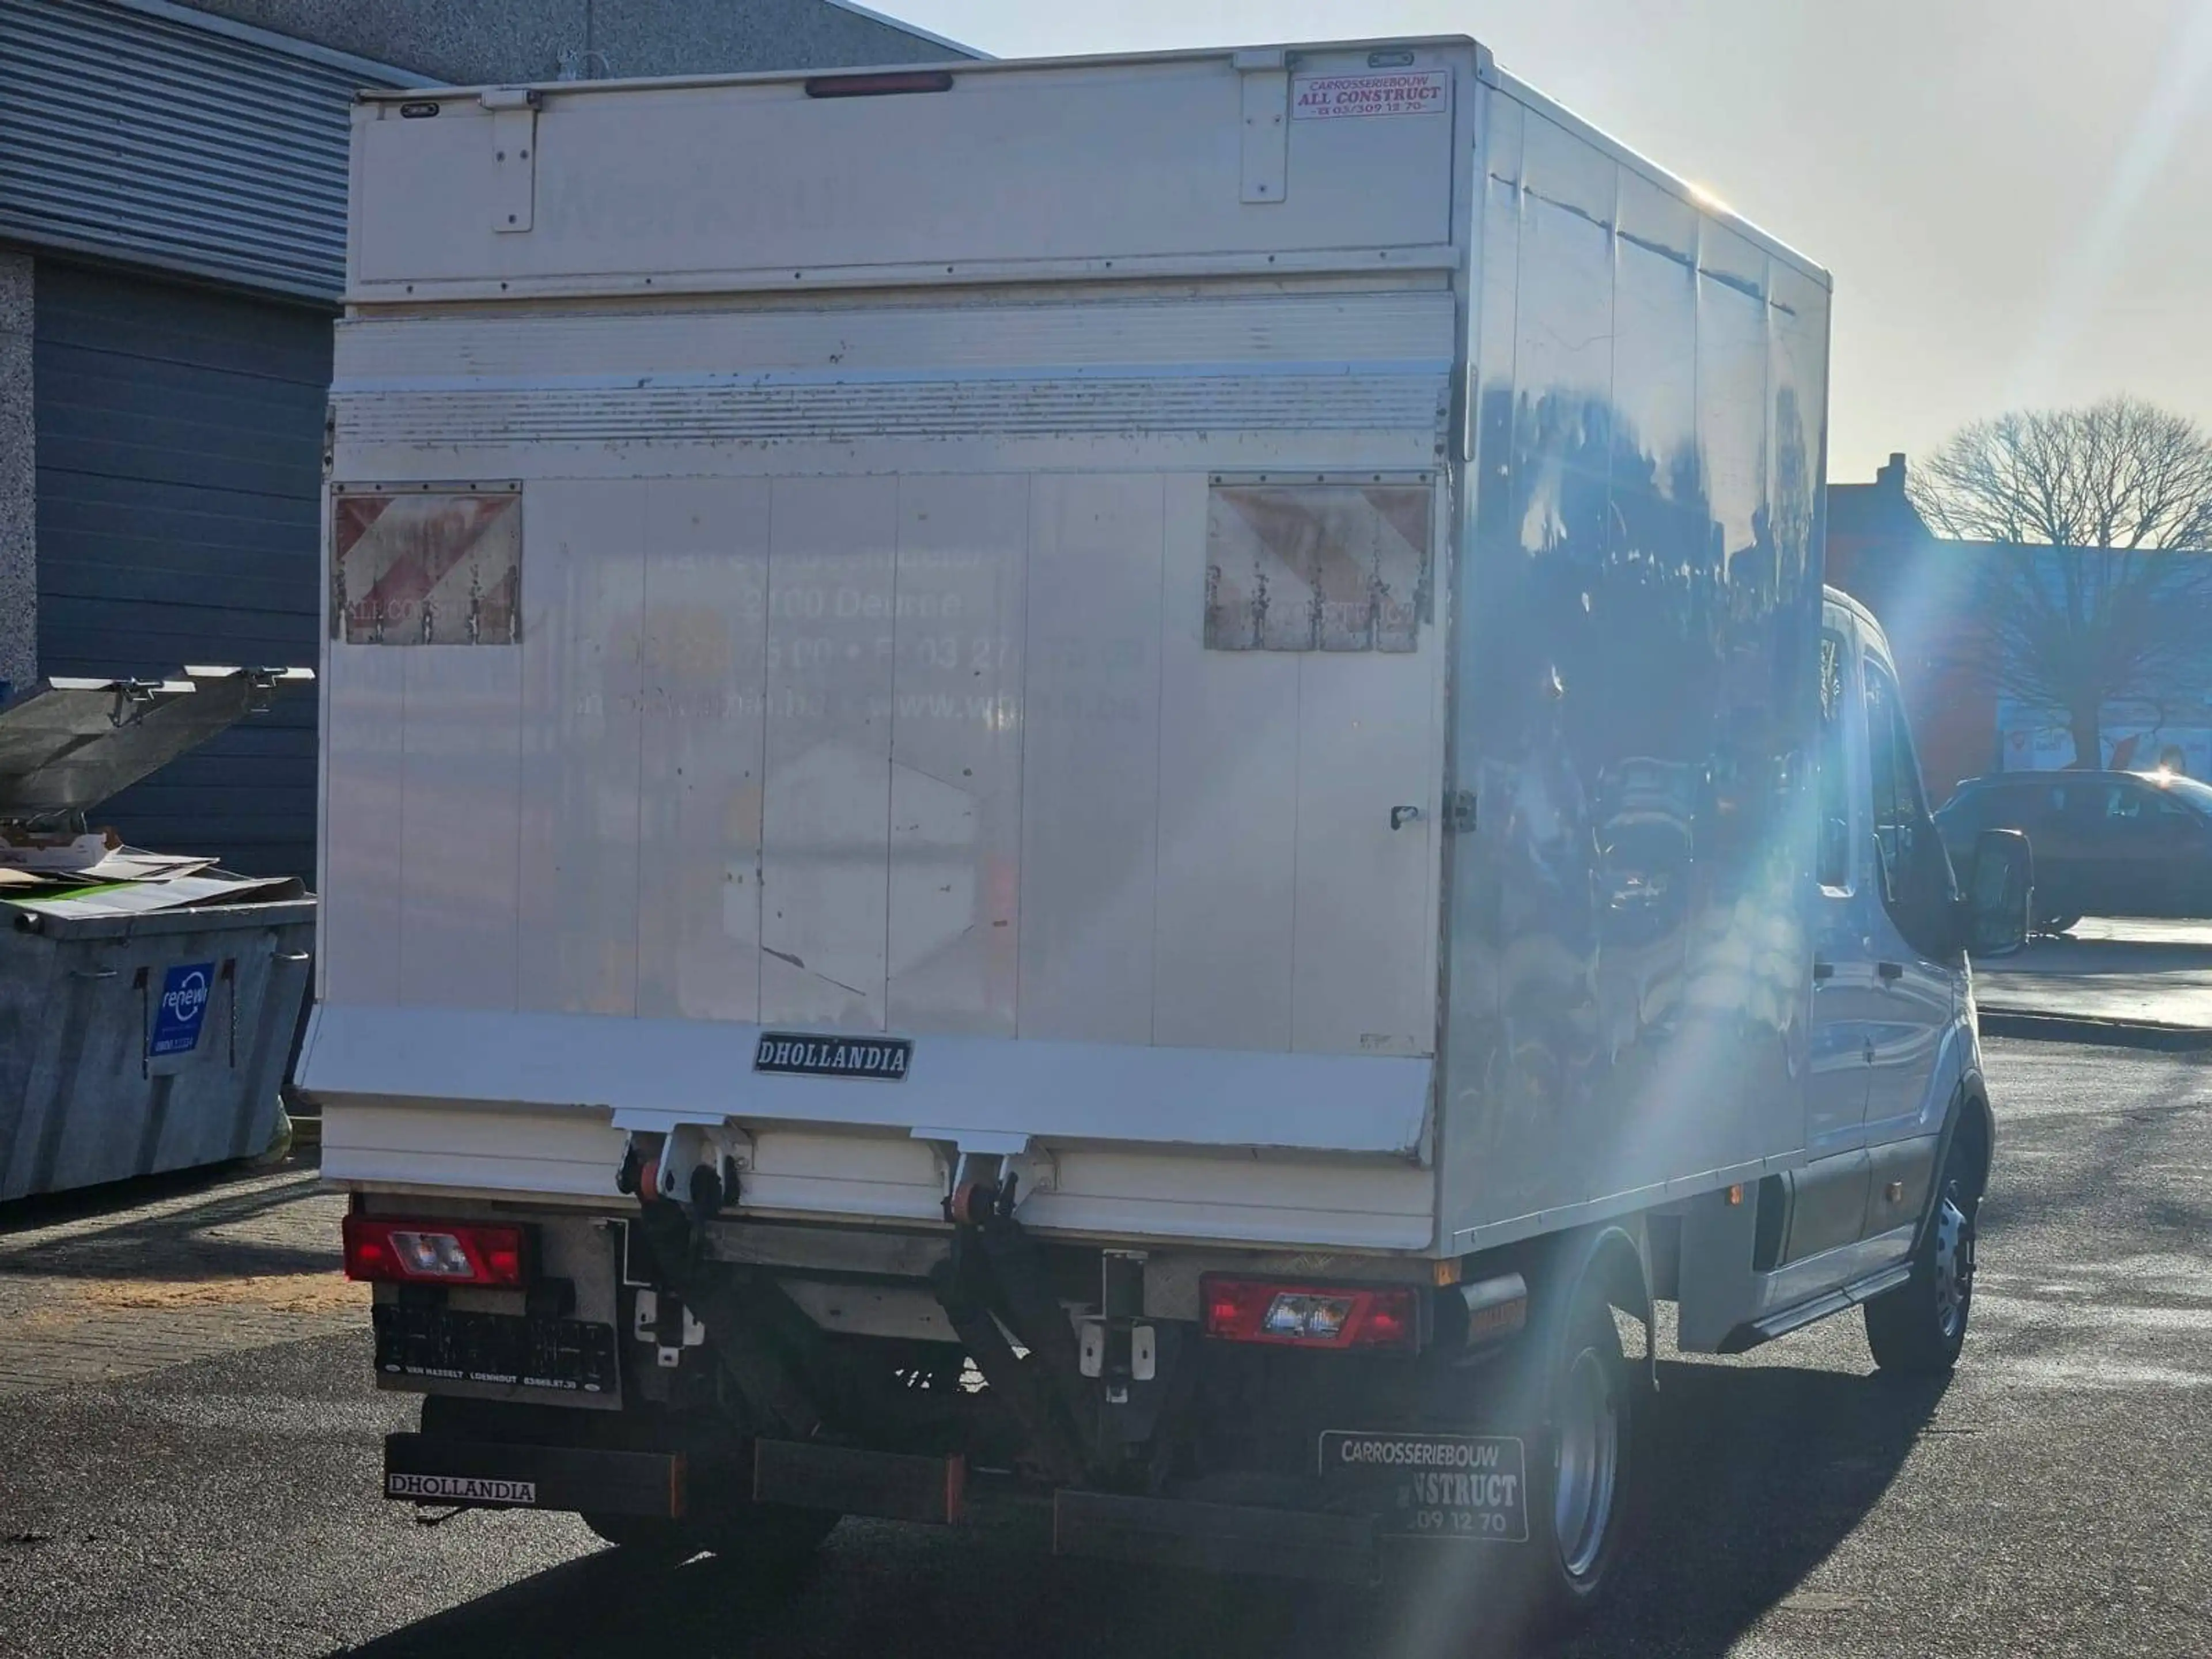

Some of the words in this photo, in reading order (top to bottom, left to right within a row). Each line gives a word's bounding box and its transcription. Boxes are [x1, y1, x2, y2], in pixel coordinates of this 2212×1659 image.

[1298, 92, 1331, 106] ALL
[1336, 86, 1441, 105] CONSTRUCT
[758, 1041, 905, 1071] DHOLLANDIA
[1341, 1440, 1499, 1467] CARROSSERIEBOUW
[392, 1476, 534, 1501] DHOLLANDIA
[1412, 1472, 1517, 1507] NSTRUCT
[1451, 1512, 1473, 1531] 12
[1481, 1513, 1506, 1532] 70
